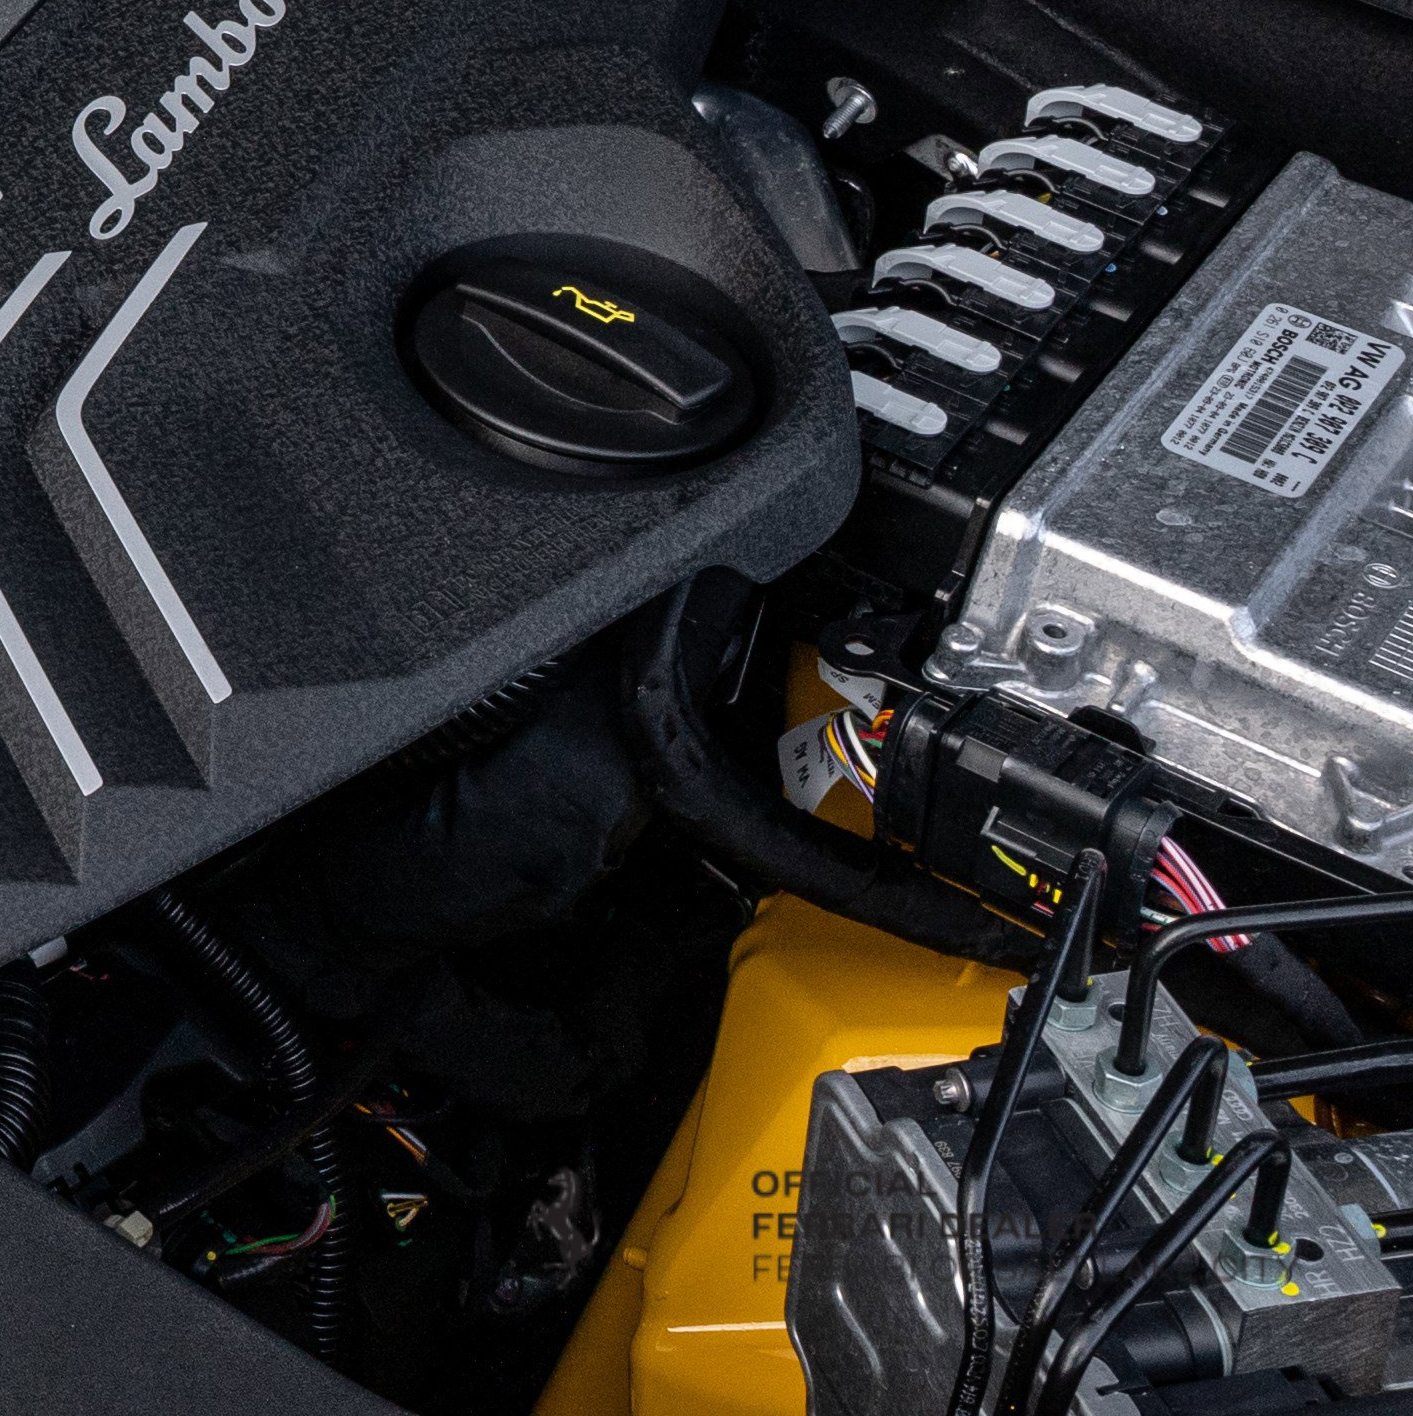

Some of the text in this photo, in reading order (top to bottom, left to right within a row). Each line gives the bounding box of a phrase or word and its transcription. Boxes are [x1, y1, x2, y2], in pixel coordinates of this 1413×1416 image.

[1261, 329, 1298, 365] BOSCH
[1356, 342, 1391, 369] VW
[1338, 365, 1369, 390] AG
[1228, 402, 1248, 419] Made
[1198, 428, 1228, 456] Germany
[1291, 452, 1317, 464] C
[1314, 592, 1379, 656] BOSCH
